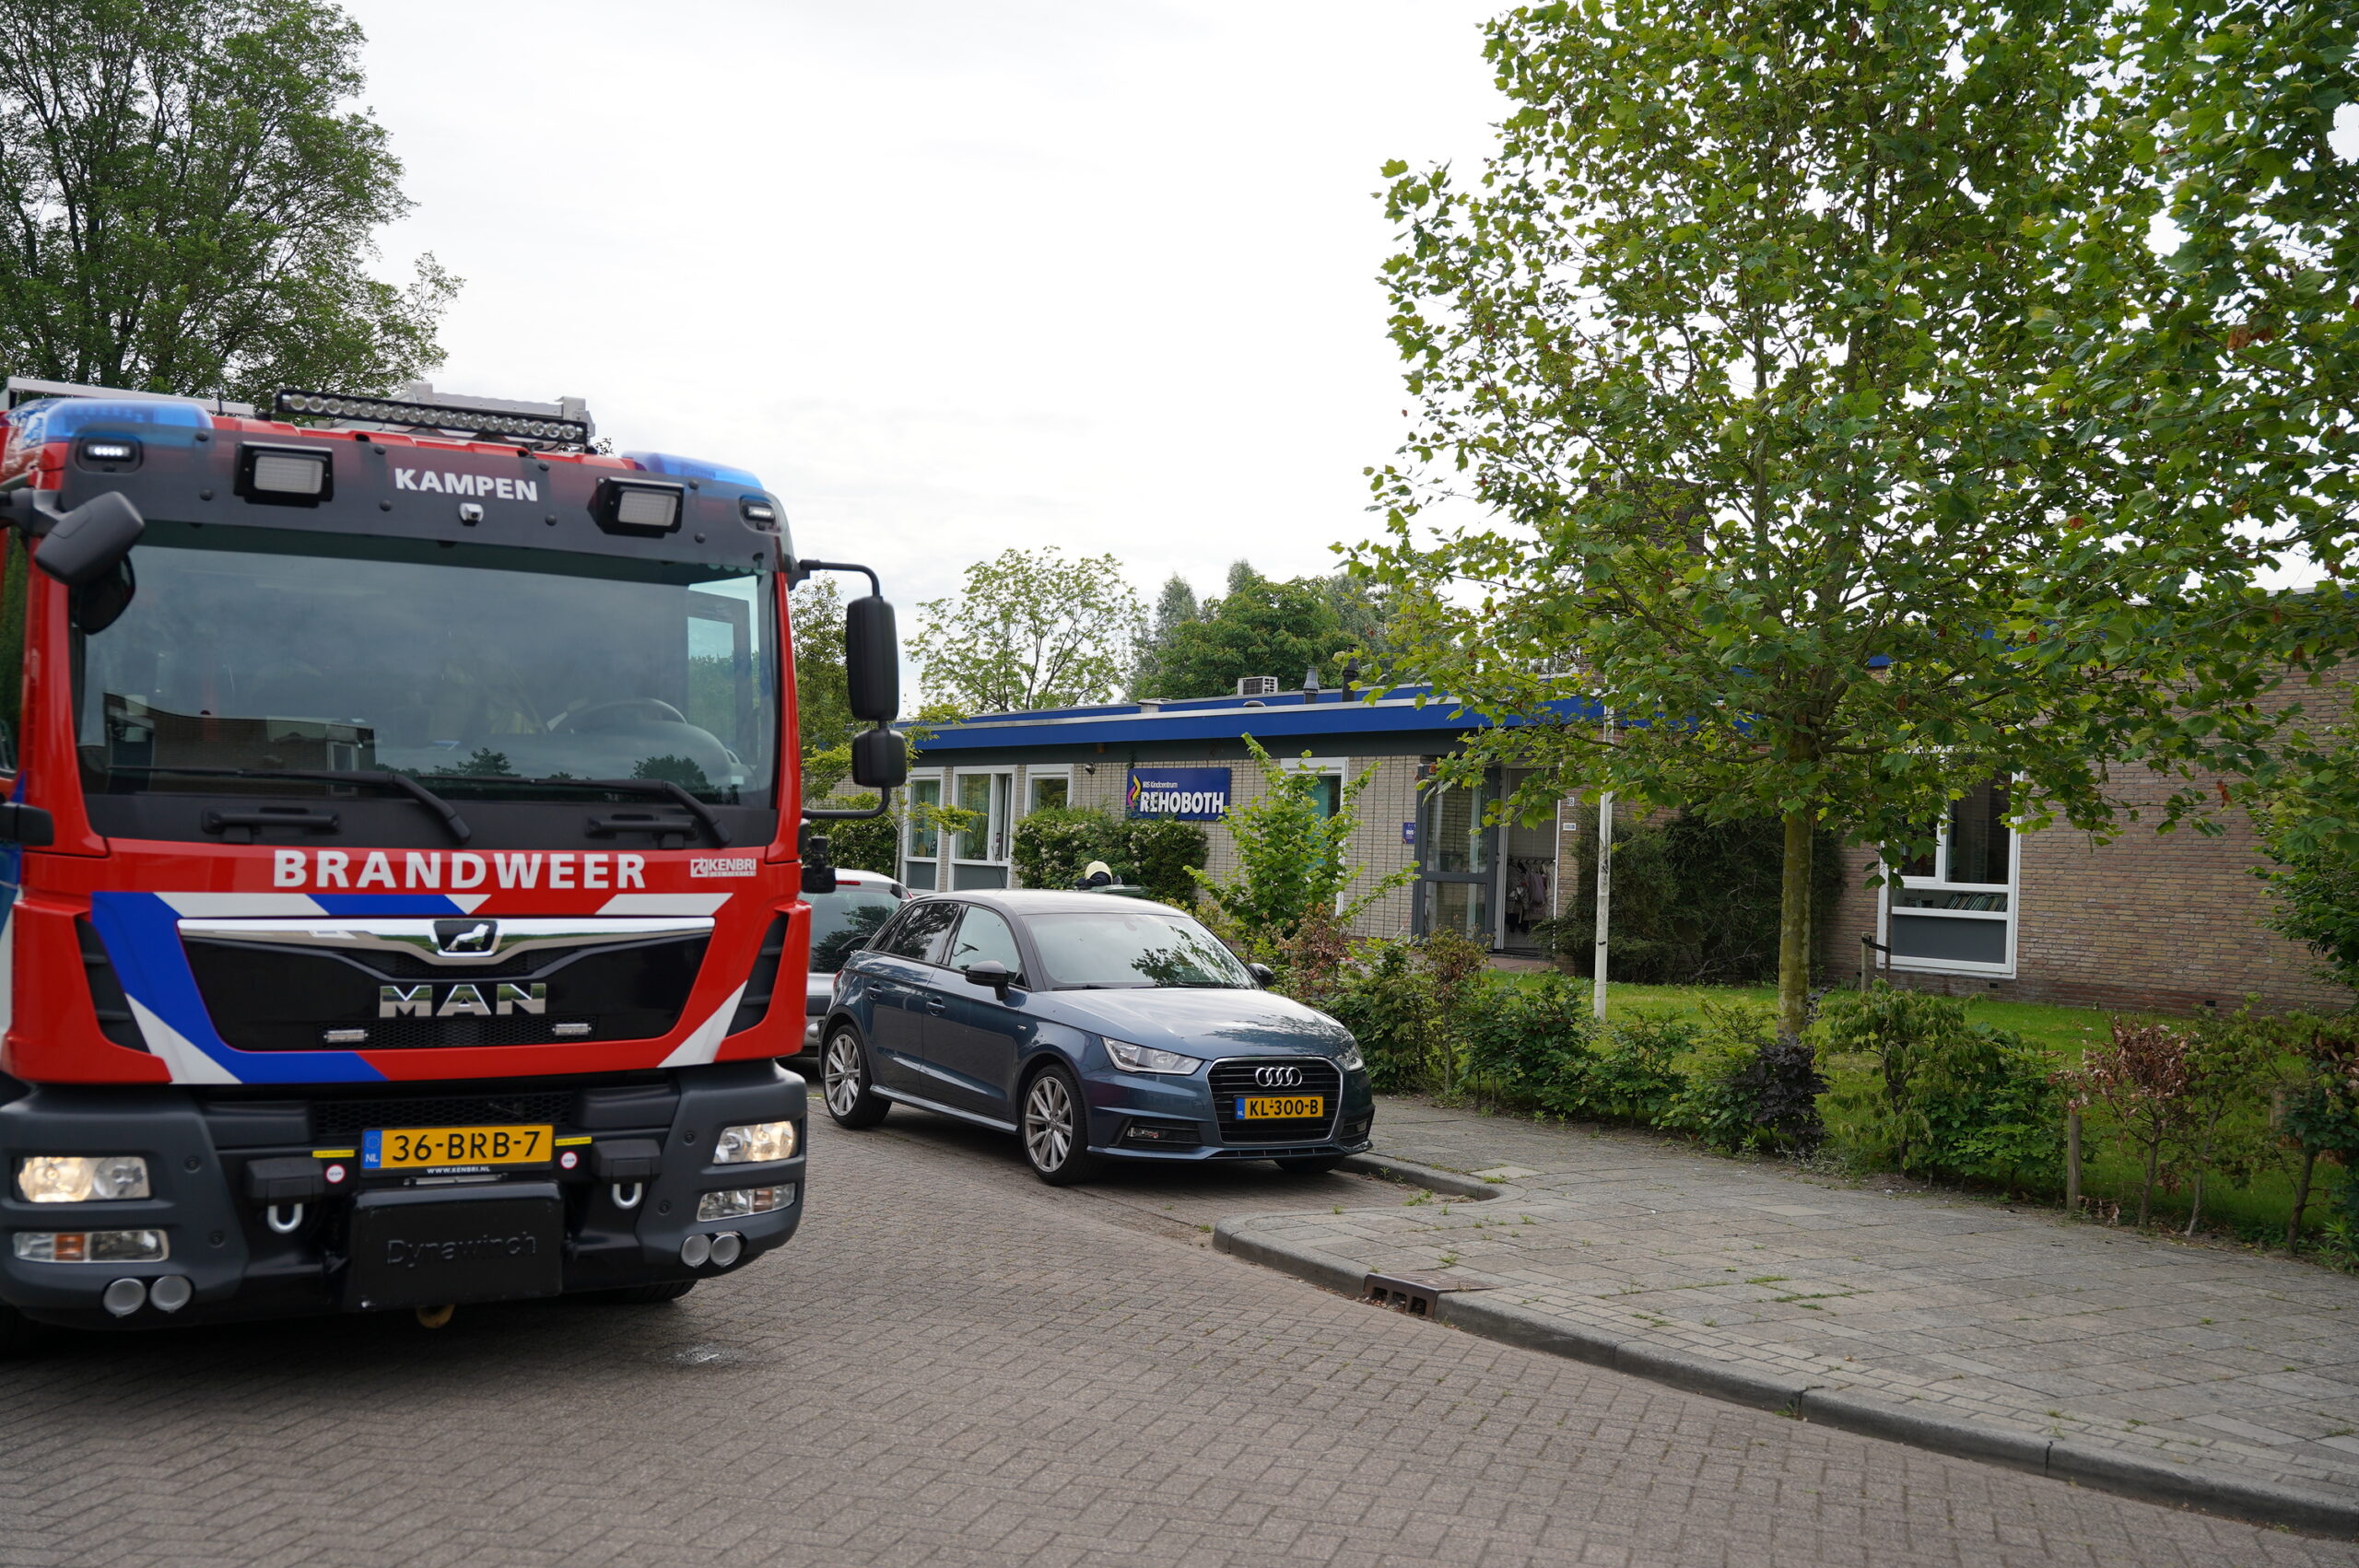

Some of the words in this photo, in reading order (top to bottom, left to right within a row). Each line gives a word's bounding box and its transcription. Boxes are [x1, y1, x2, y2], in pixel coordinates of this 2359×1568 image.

[394, 467, 538, 502] KAMPEN
[1140, 791, 1225, 813] REHOBOTH
[274, 849, 646, 890] BRANDWEER
[709, 858, 757, 872] KENBRI
[379, 983, 546, 1018] MAN
[1250, 1099, 1319, 1117] KL-300-B
[365, 1153, 379, 1163] NL
[392, 1131, 541, 1162] 36-BRB-7
[427, 1165, 490, 1174] WWW.KENBRI.NL
[387, 1231, 536, 1269] Dynawinch
